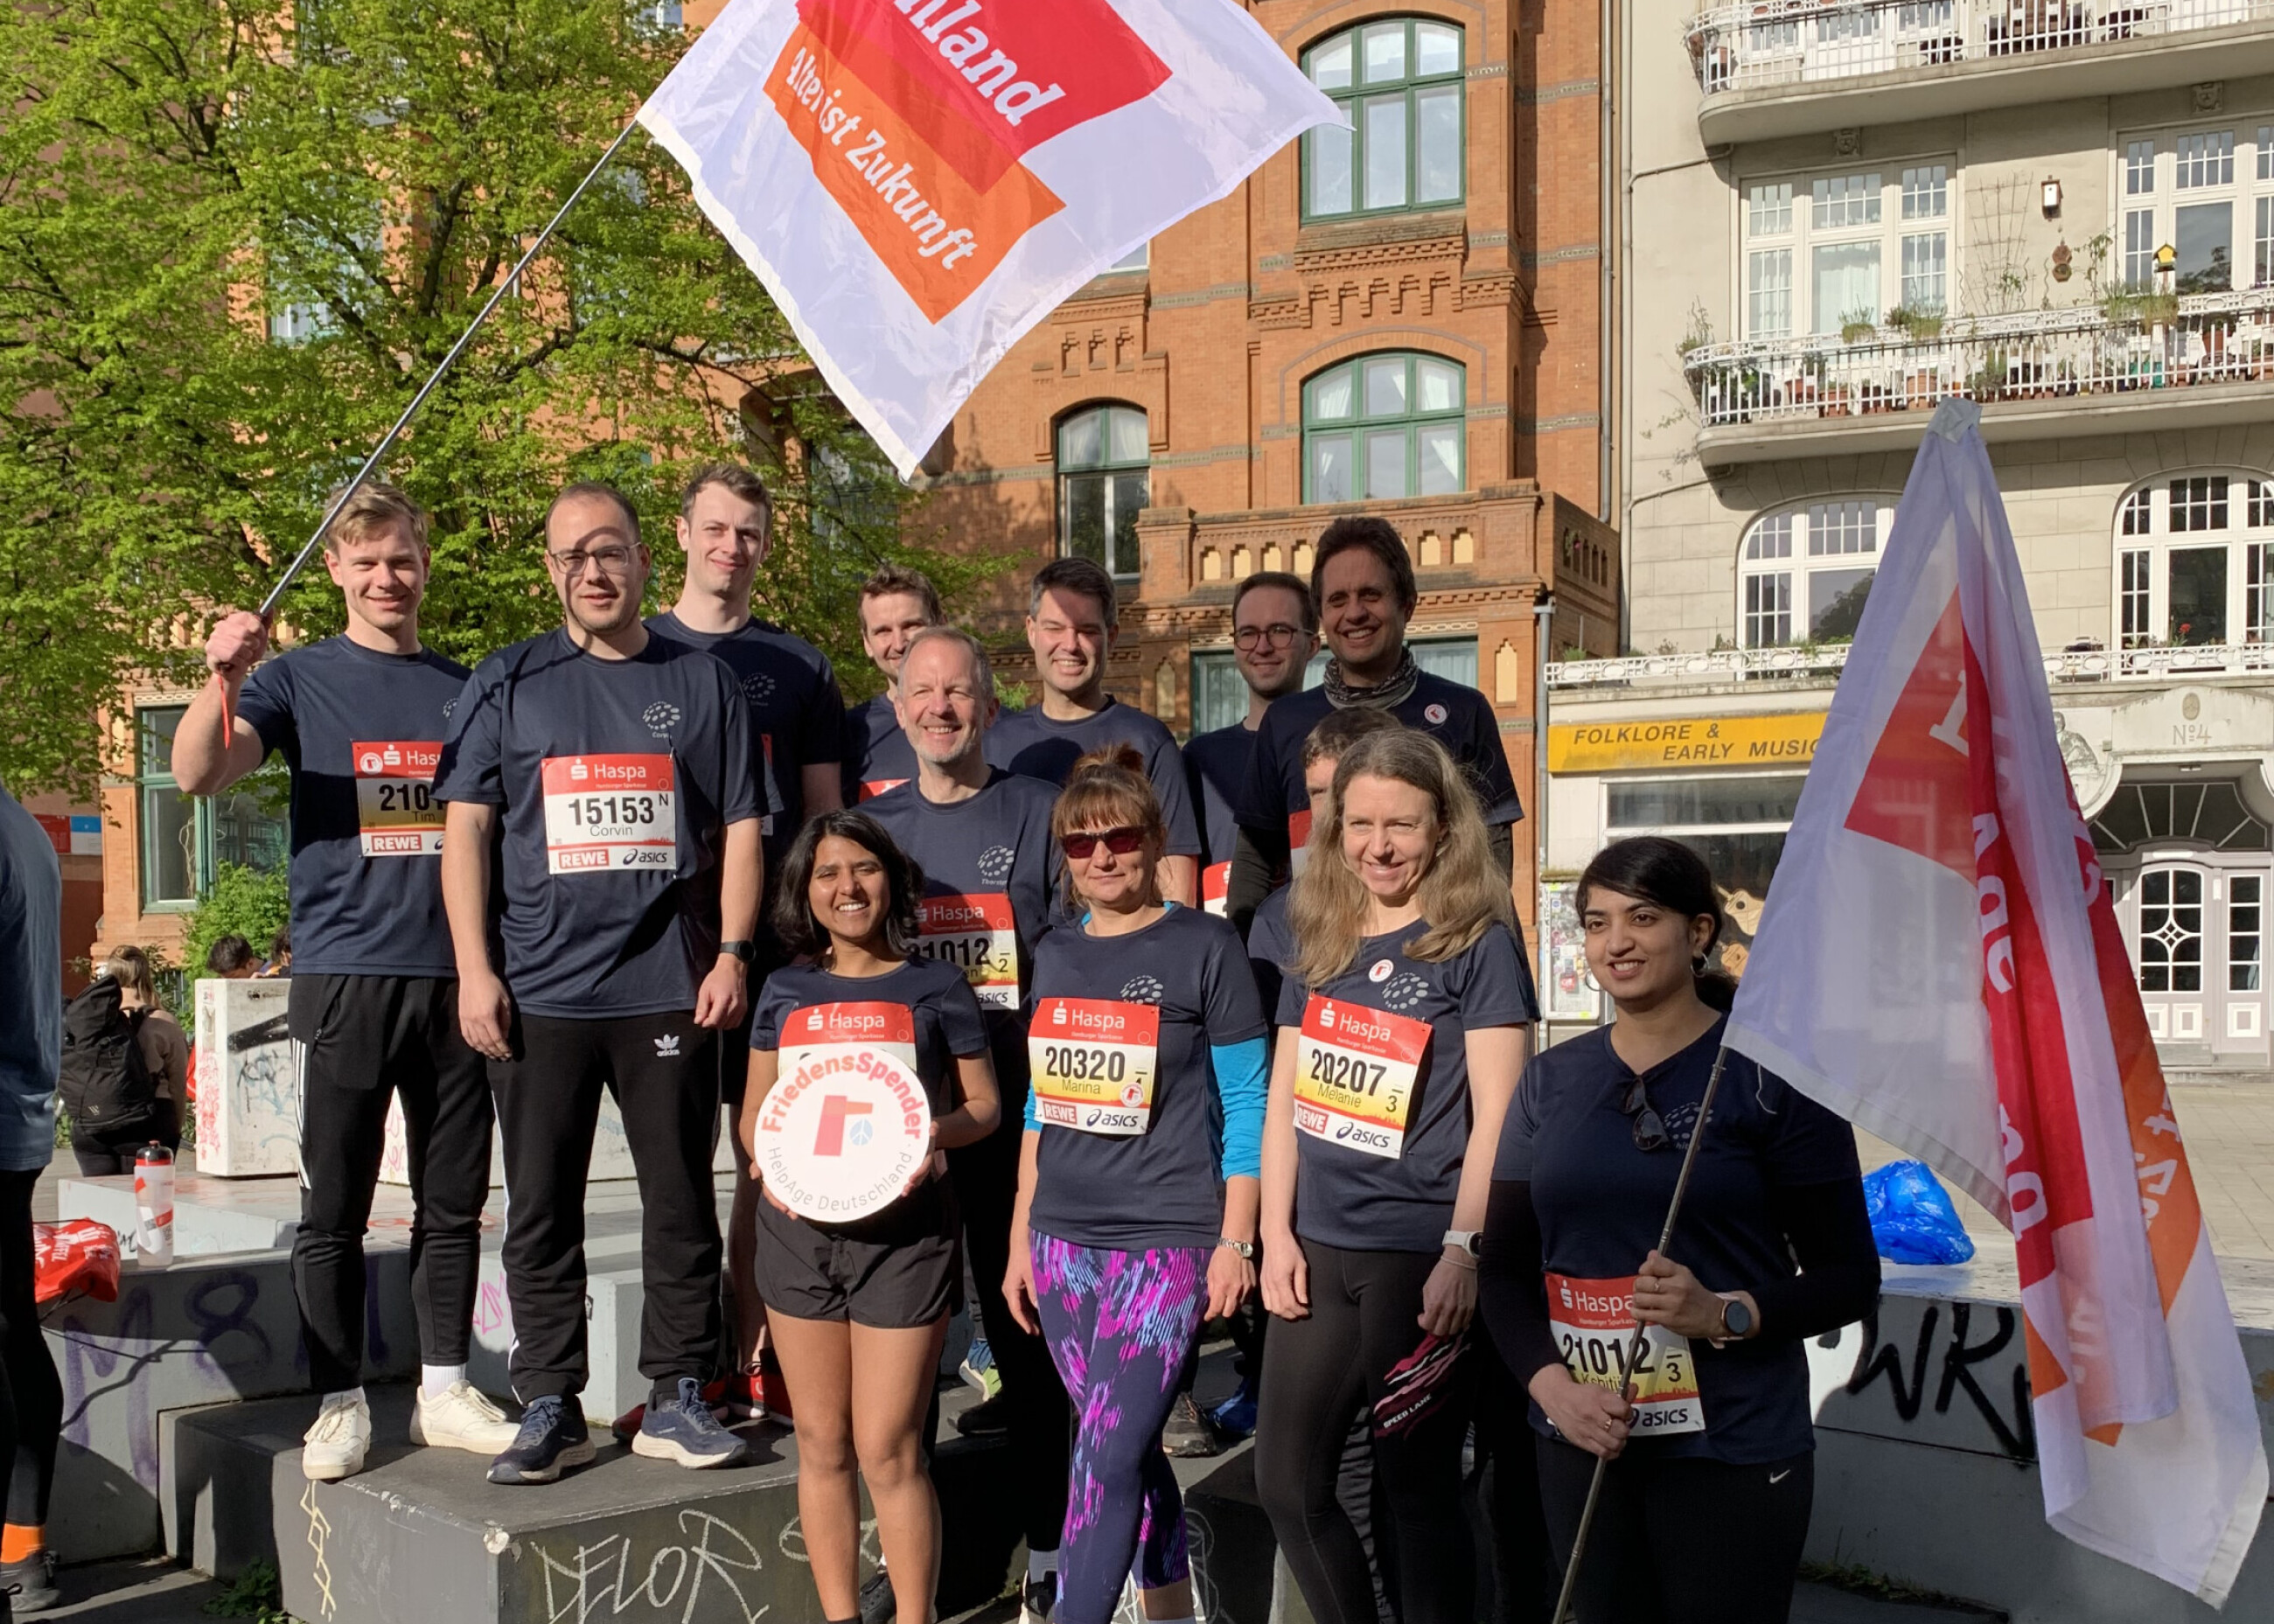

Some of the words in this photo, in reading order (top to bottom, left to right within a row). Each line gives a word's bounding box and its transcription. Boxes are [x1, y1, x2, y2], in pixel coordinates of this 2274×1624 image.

[818, 89, 861, 146] ist
[845, 129, 978, 270] Zukunft
[1574, 724, 1692, 744] FOLKLORE
[1706, 723, 1719, 738] &
[1663, 742, 1734, 761] EARLY
[594, 763, 646, 782] Haspa
[379, 784, 443, 812] 210
[568, 797, 654, 826] 15153
[659, 793, 669, 806] N
[411, 811, 436, 823] Tim
[589, 824, 633, 837] Corvin
[373, 836, 421, 852] REWE
[561, 851, 608, 868] REWE
[933, 906, 984, 923] Haspa
[999, 958, 1008, 972] 2
[829, 1013, 885, 1032] Haspa
[1071, 1009, 1125, 1032] Haspa
[1339, 1013, 1392, 1042] Haspa
[1045, 1046, 1126, 1083] 20320
[1062, 1079, 1101, 1094] Marina
[1310, 1049, 1387, 1097] 20207
[1385, 1095, 1398, 1113] 3
[761, 1051, 924, 1140] FriedensSpender
[1318, 1084, 1362, 1108] Melanie
[1044, 1105, 1077, 1124] REWE
[1298, 1107, 1326, 1131] REWE
[768, 1147, 813, 1205] HelpAge
[818, 1151, 912, 1211] Deutschland
[1575, 1291, 1635, 1317] Haspa
[1563, 1333, 1655, 1376] 21012
[1666, 1362, 1681, 1382] 3
